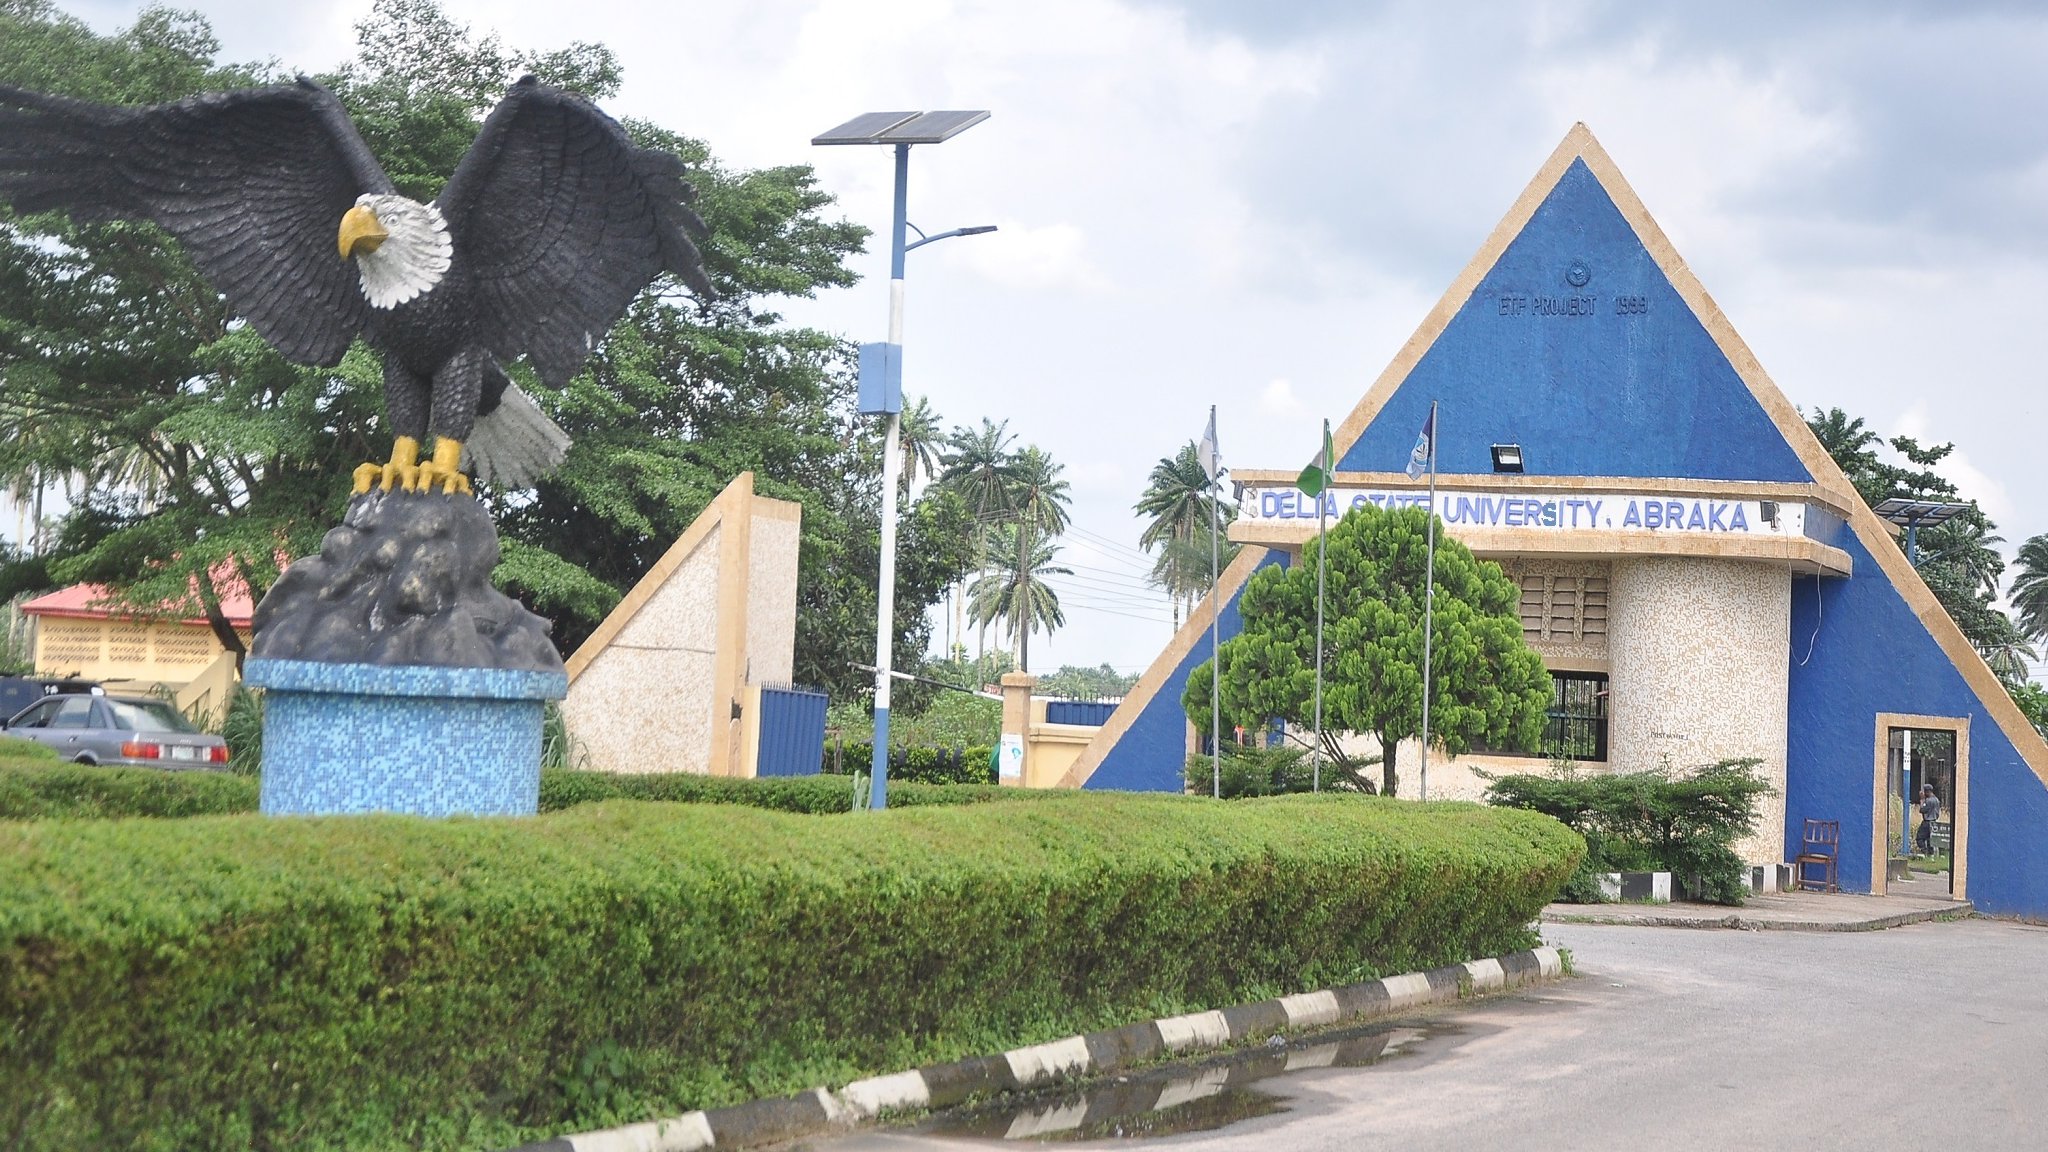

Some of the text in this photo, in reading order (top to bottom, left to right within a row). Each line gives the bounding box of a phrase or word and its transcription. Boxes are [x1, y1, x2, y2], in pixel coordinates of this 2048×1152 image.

[1499, 297, 1648, 316] ETF PROJECT 1999
[1623, 500, 1748, 531] ABRAKA
